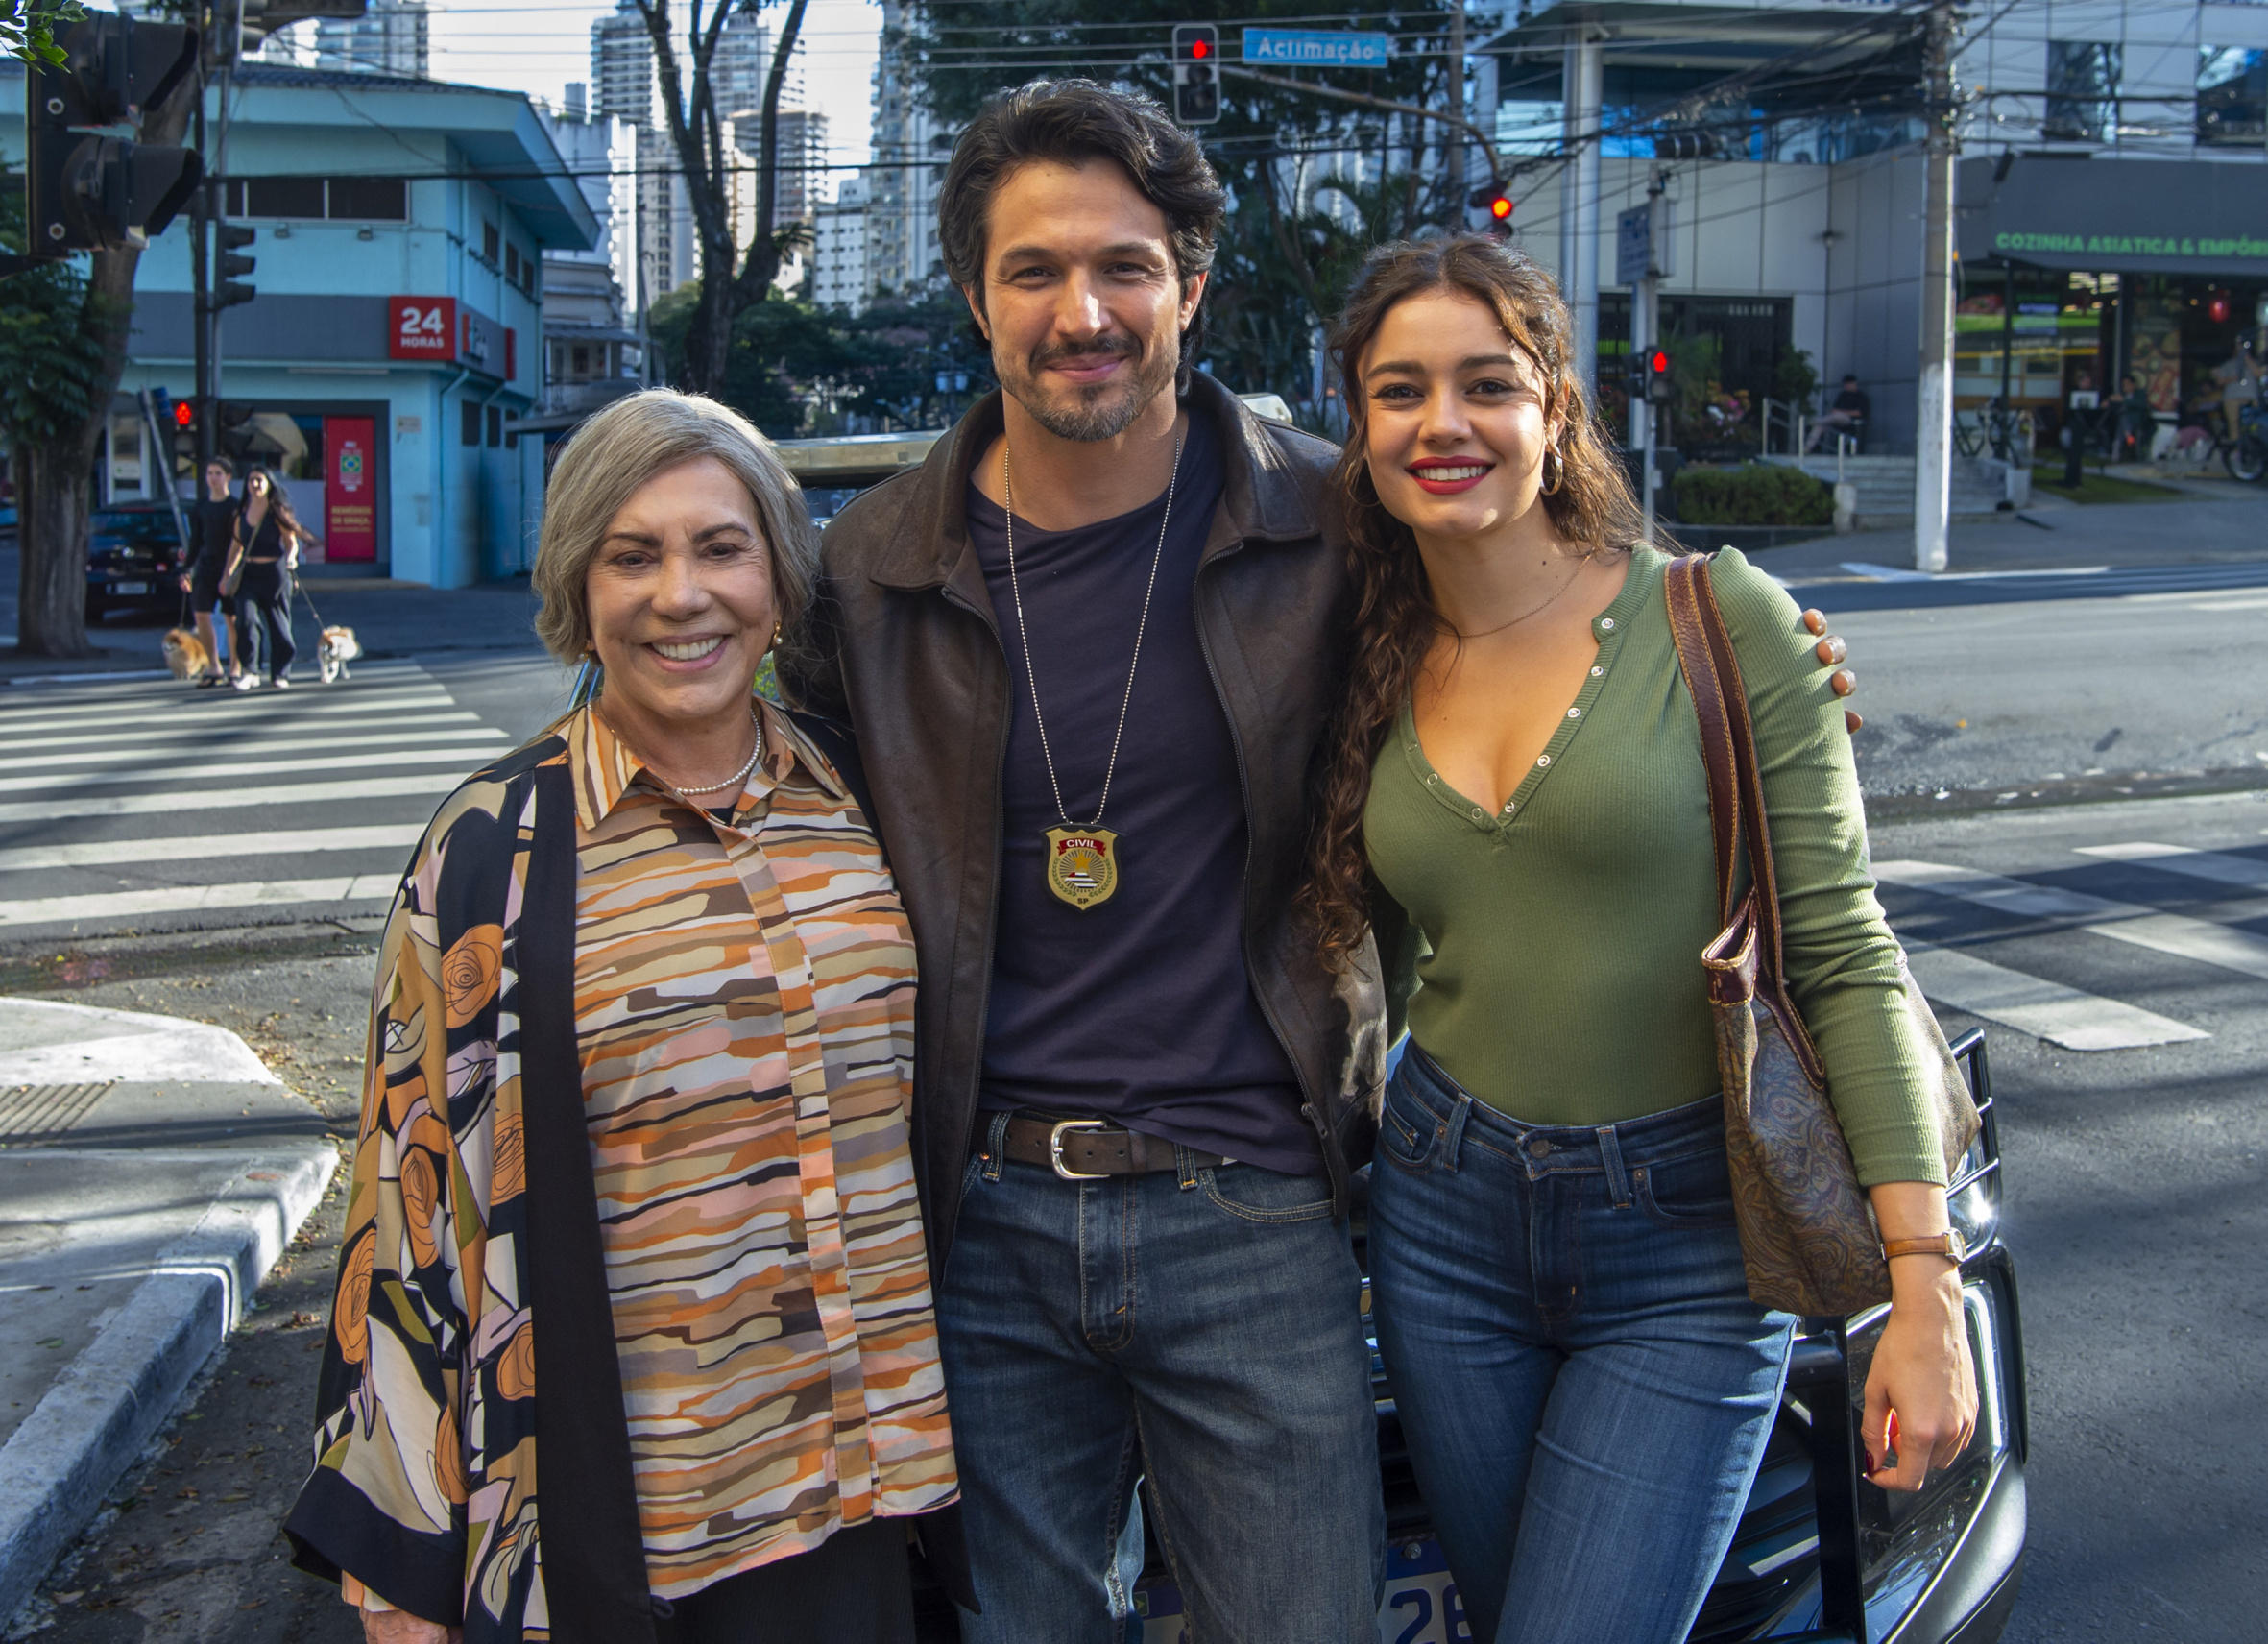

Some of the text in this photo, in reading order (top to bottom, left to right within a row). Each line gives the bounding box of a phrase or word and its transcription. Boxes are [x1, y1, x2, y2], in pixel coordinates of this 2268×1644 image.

[1258, 36, 1374, 63] Aclimação
[1995, 232, 2085, 252] COZINHA
[2087, 235, 2178, 254] ASIATICA
[2180, 238, 2195, 255] &
[400, 307, 445, 334] 24
[400, 335, 445, 348] HORAS
[1066, 838, 1098, 849] CIVIL
